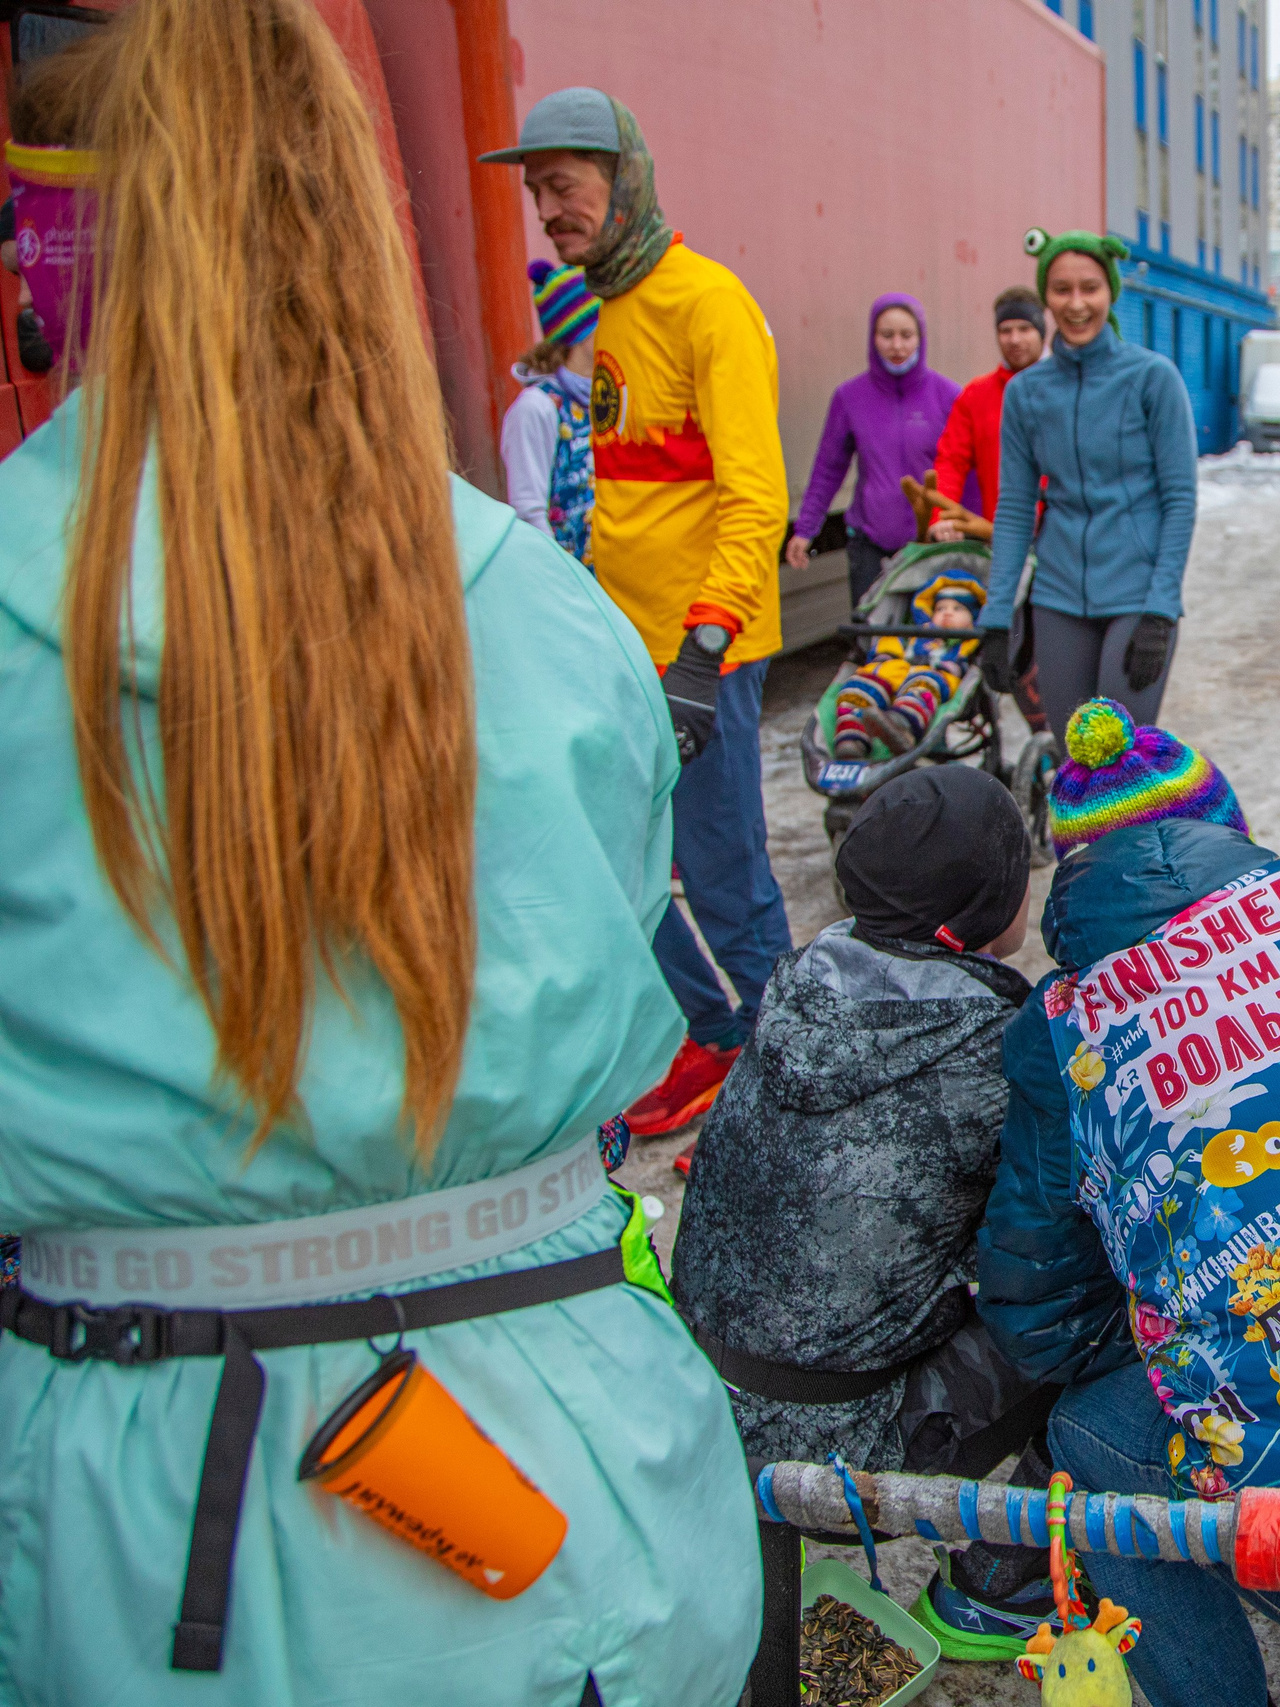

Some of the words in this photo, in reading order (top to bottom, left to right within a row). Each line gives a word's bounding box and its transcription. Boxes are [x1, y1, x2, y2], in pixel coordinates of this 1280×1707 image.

[1149, 986, 1210, 1039] 100
[116, 1248, 195, 1291] GO
[209, 1209, 453, 1289] STRONG
[465, 1194, 529, 1242] GO
